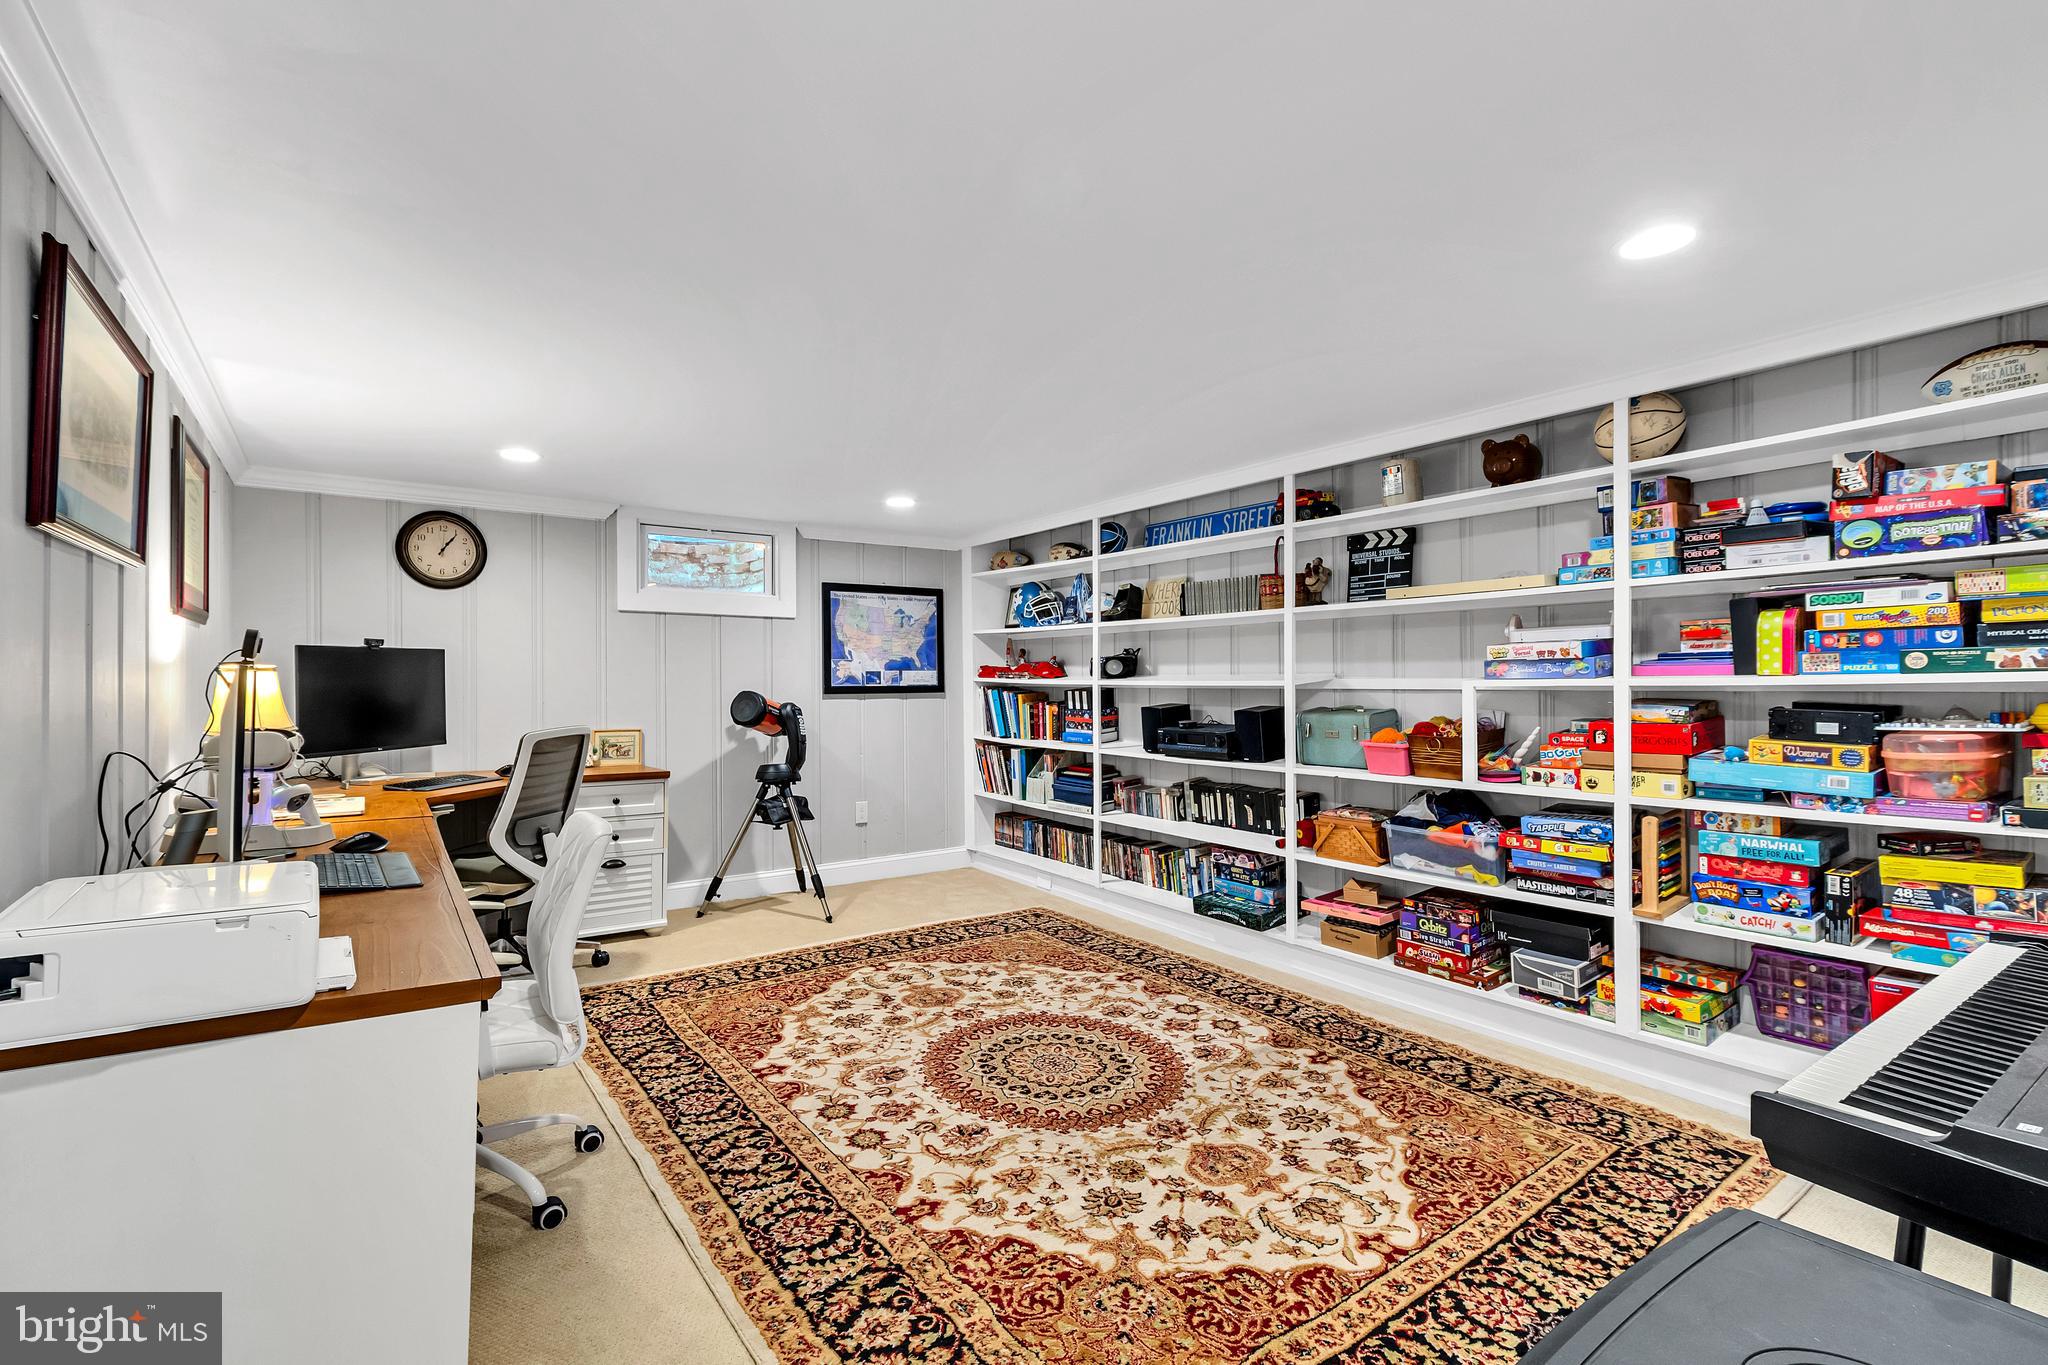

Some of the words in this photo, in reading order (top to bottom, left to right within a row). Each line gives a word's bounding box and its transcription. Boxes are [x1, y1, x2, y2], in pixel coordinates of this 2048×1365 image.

[1971, 369, 1996, 384] CHRIS
[1999, 362, 2026, 378] ALLEN
[1875, 505, 1894, 513] MAP
[1896, 503, 1907, 511] OF
[1928, 499, 1954, 508] U.S.A.
[1151, 517, 1213, 546] FRANKLIN
[1222, 505, 1275, 534] STREET
[1685, 534, 1703, 542] POKER
[1684, 550, 1702, 558] POKER
[1810, 592, 1864, 606] SORRY!
[1991, 604, 2048, 616] PICTION
[1987, 629, 2026, 637] MYTHICAL
[1529, 823, 1566, 832] TAPPLE
[1554, 843, 1574, 853] CLUE
[1740, 838, 1805, 853] NARWHAL
[1741, 847, 1763, 857] FREE
[1766, 850, 1781, 858] FOR
[1783, 851, 1805, 861] ALL!
[1527, 860, 1546, 868] CHUTES
[1553, 863, 1577, 871] LADDERS
[1517, 879, 1576, 895] MASTERMIND
[1893, 887, 1914, 898] 48
[1707, 888, 1738, 900] BOAT
[1419, 918, 1448, 934] Q-bitz
[1740, 916, 1777, 929] CATCH!
[1864, 922, 1915, 937] Aggravation
[1429, 935, 1455, 947] Straight
[1601, 983, 1615, 994] Fee
